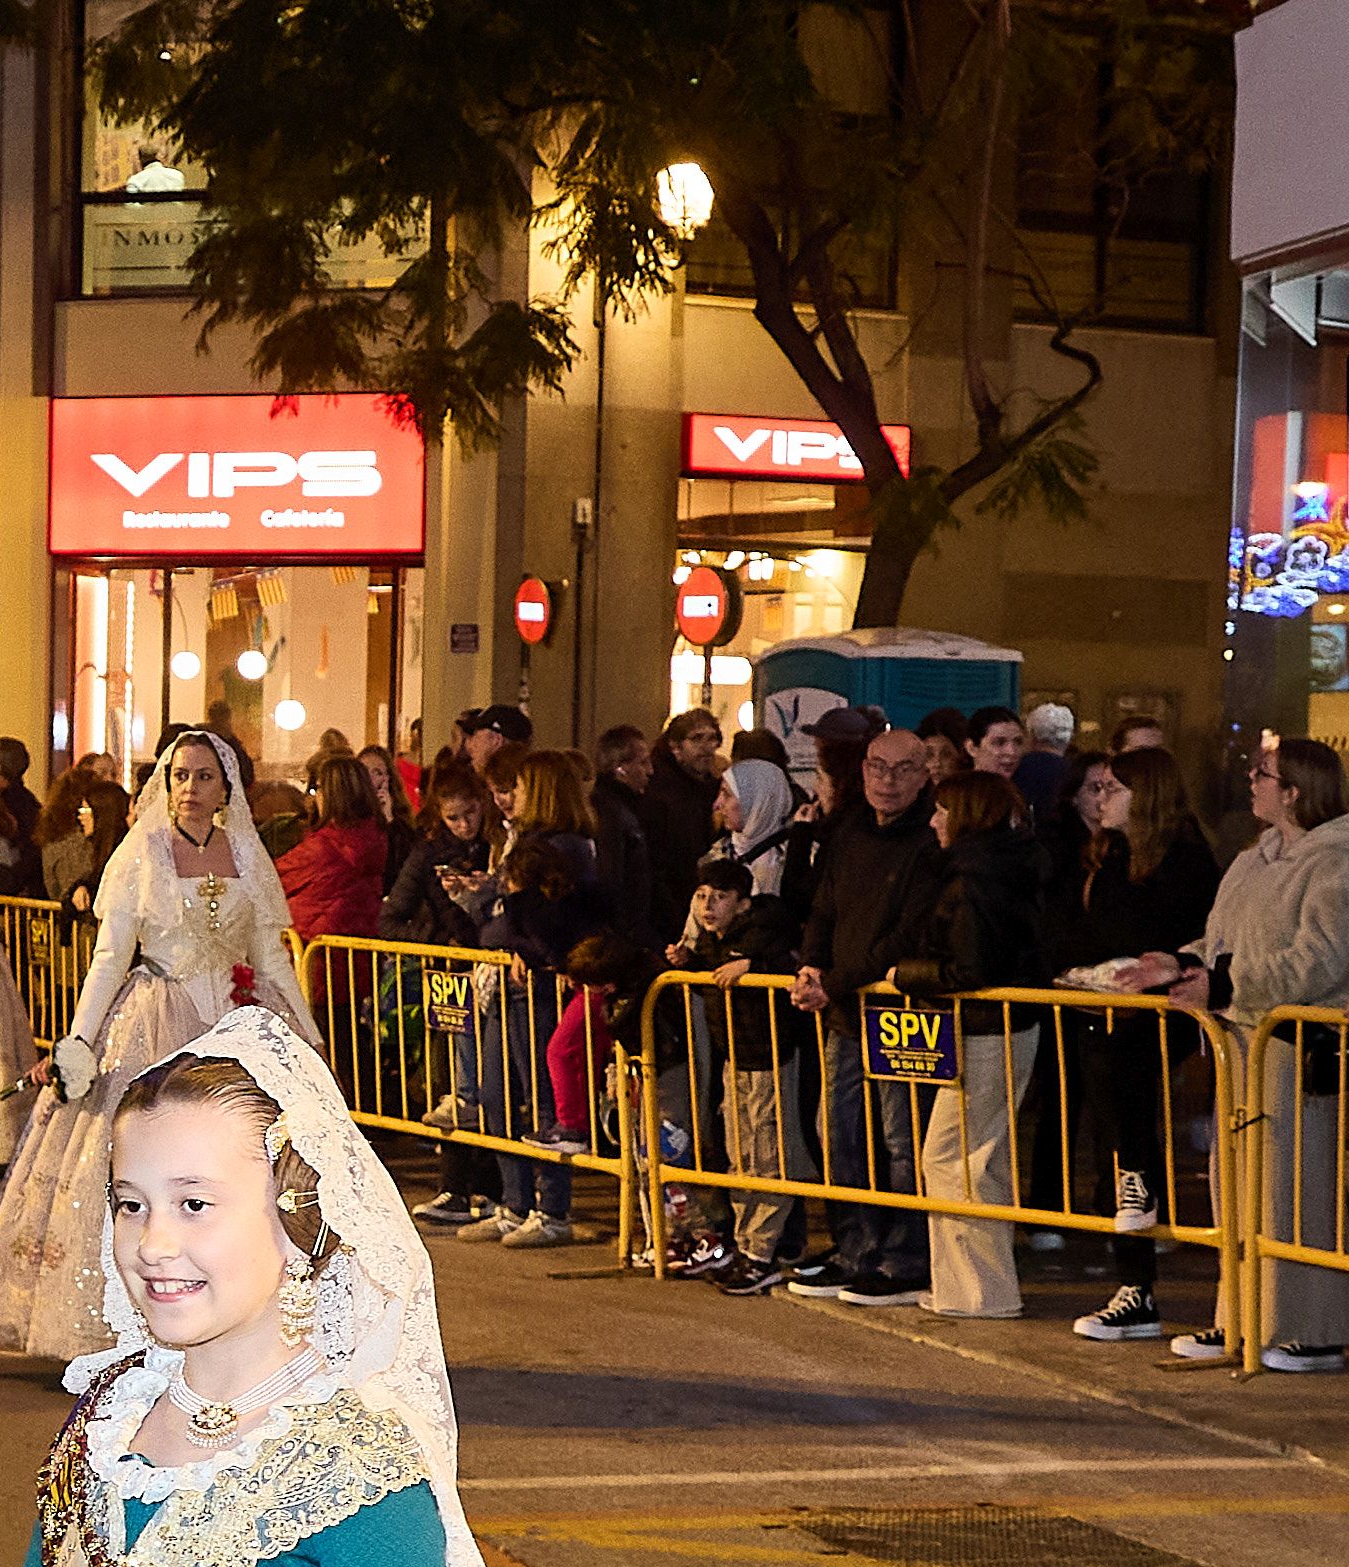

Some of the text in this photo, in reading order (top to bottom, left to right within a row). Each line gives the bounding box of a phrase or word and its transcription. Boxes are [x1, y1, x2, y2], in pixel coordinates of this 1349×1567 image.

[90, 450, 381, 498] VIPS
[431, 973, 468, 1008] SPV
[879, 1011, 941, 1050] SPV
